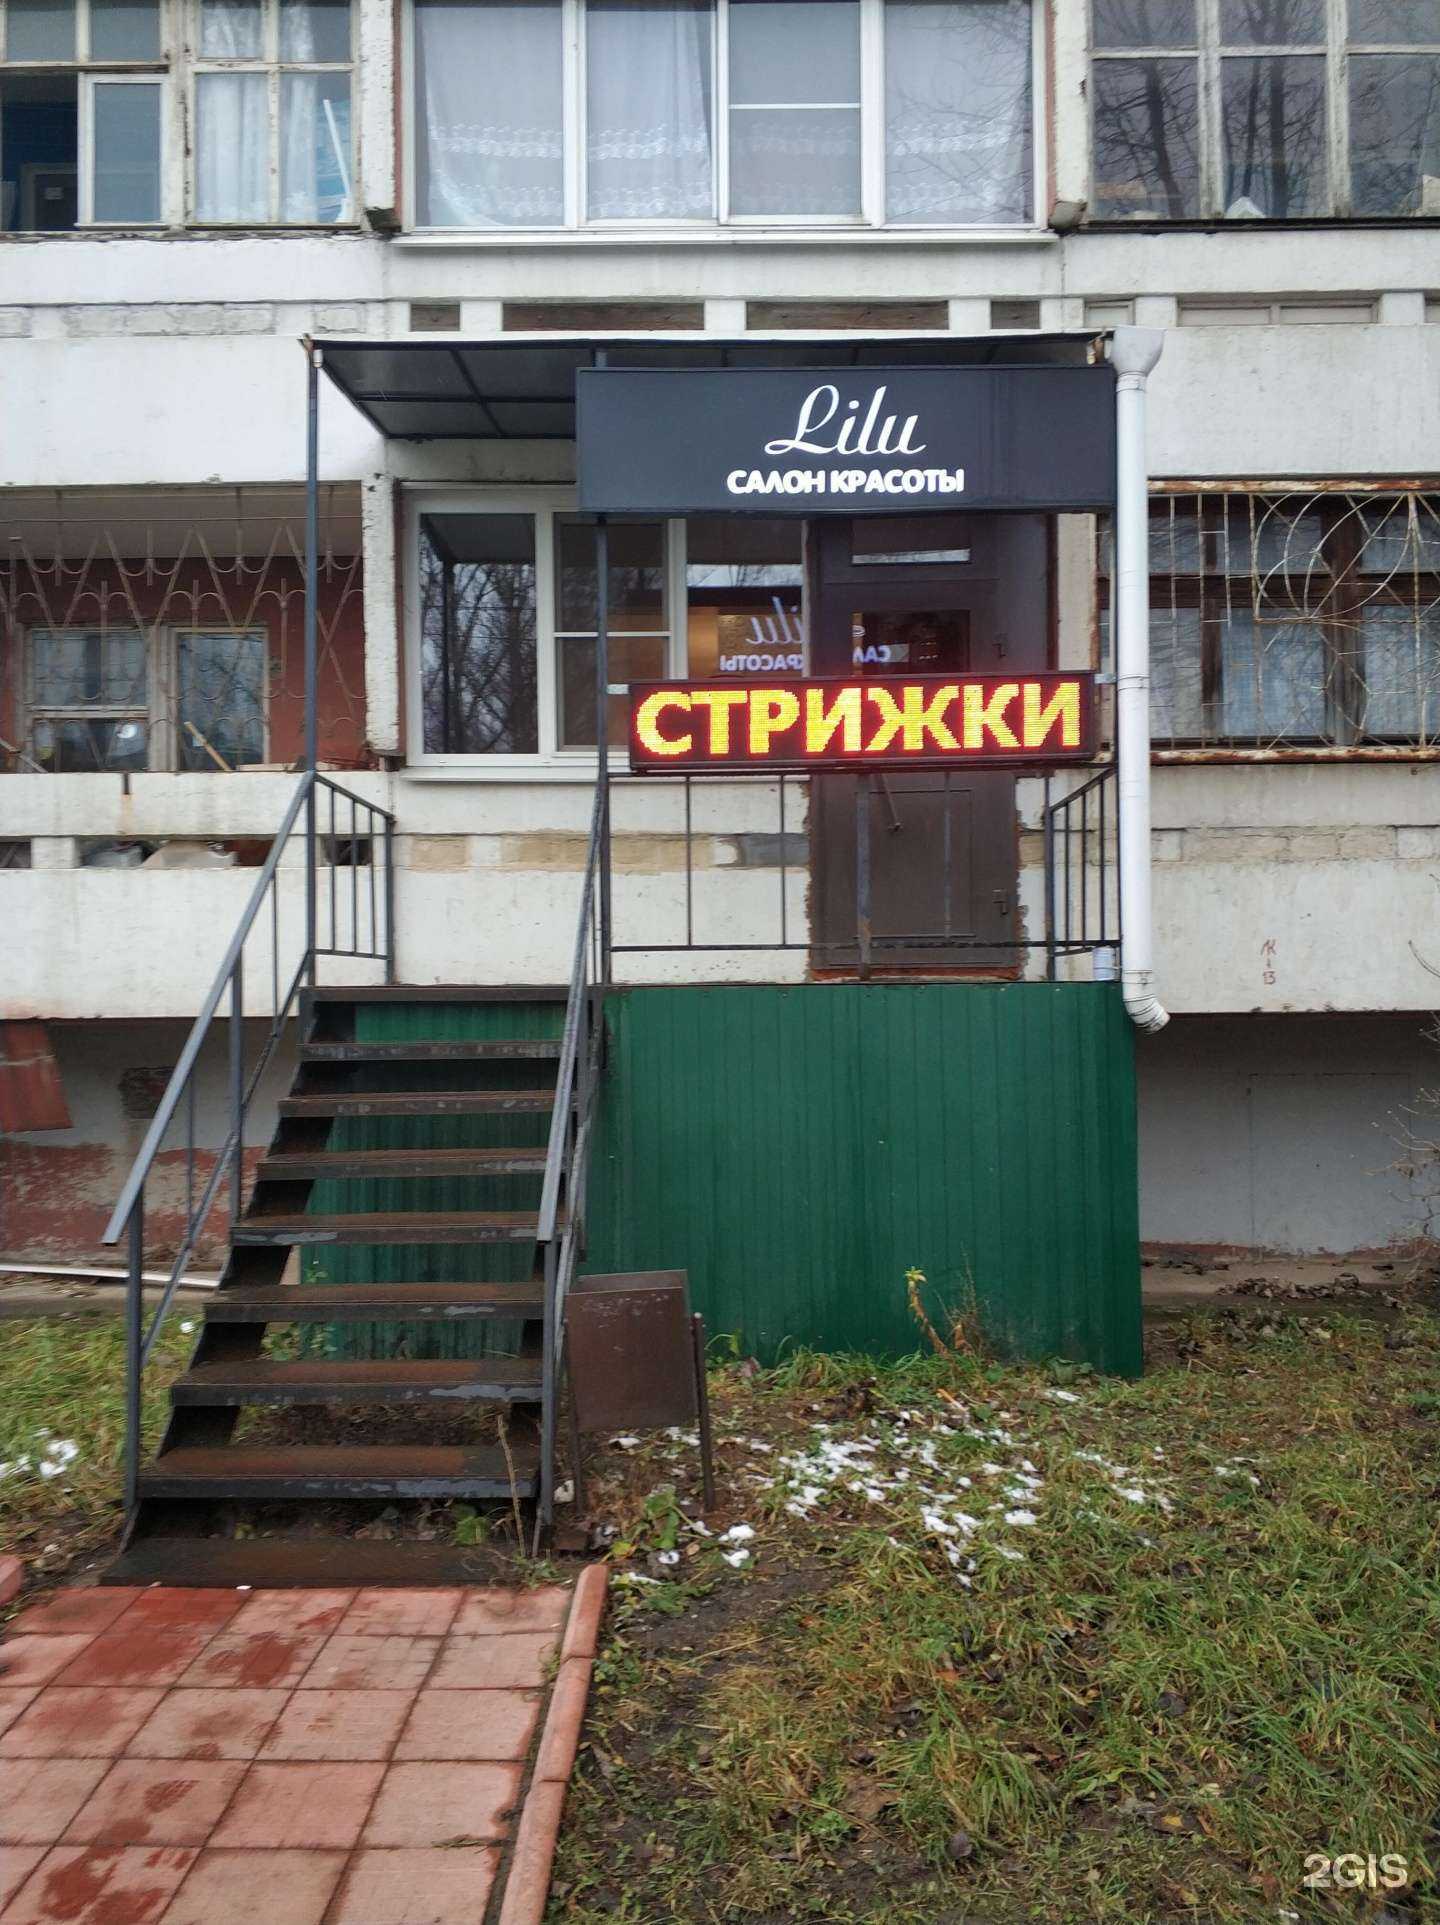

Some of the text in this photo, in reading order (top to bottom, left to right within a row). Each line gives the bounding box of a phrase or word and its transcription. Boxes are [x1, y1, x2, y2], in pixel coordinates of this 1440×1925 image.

[764, 385, 927, 455] Lilu
[727, 468, 965, 494] САЛОН КРАСОТЫ
[635, 682, 1081, 755] СТРИЖКИ
